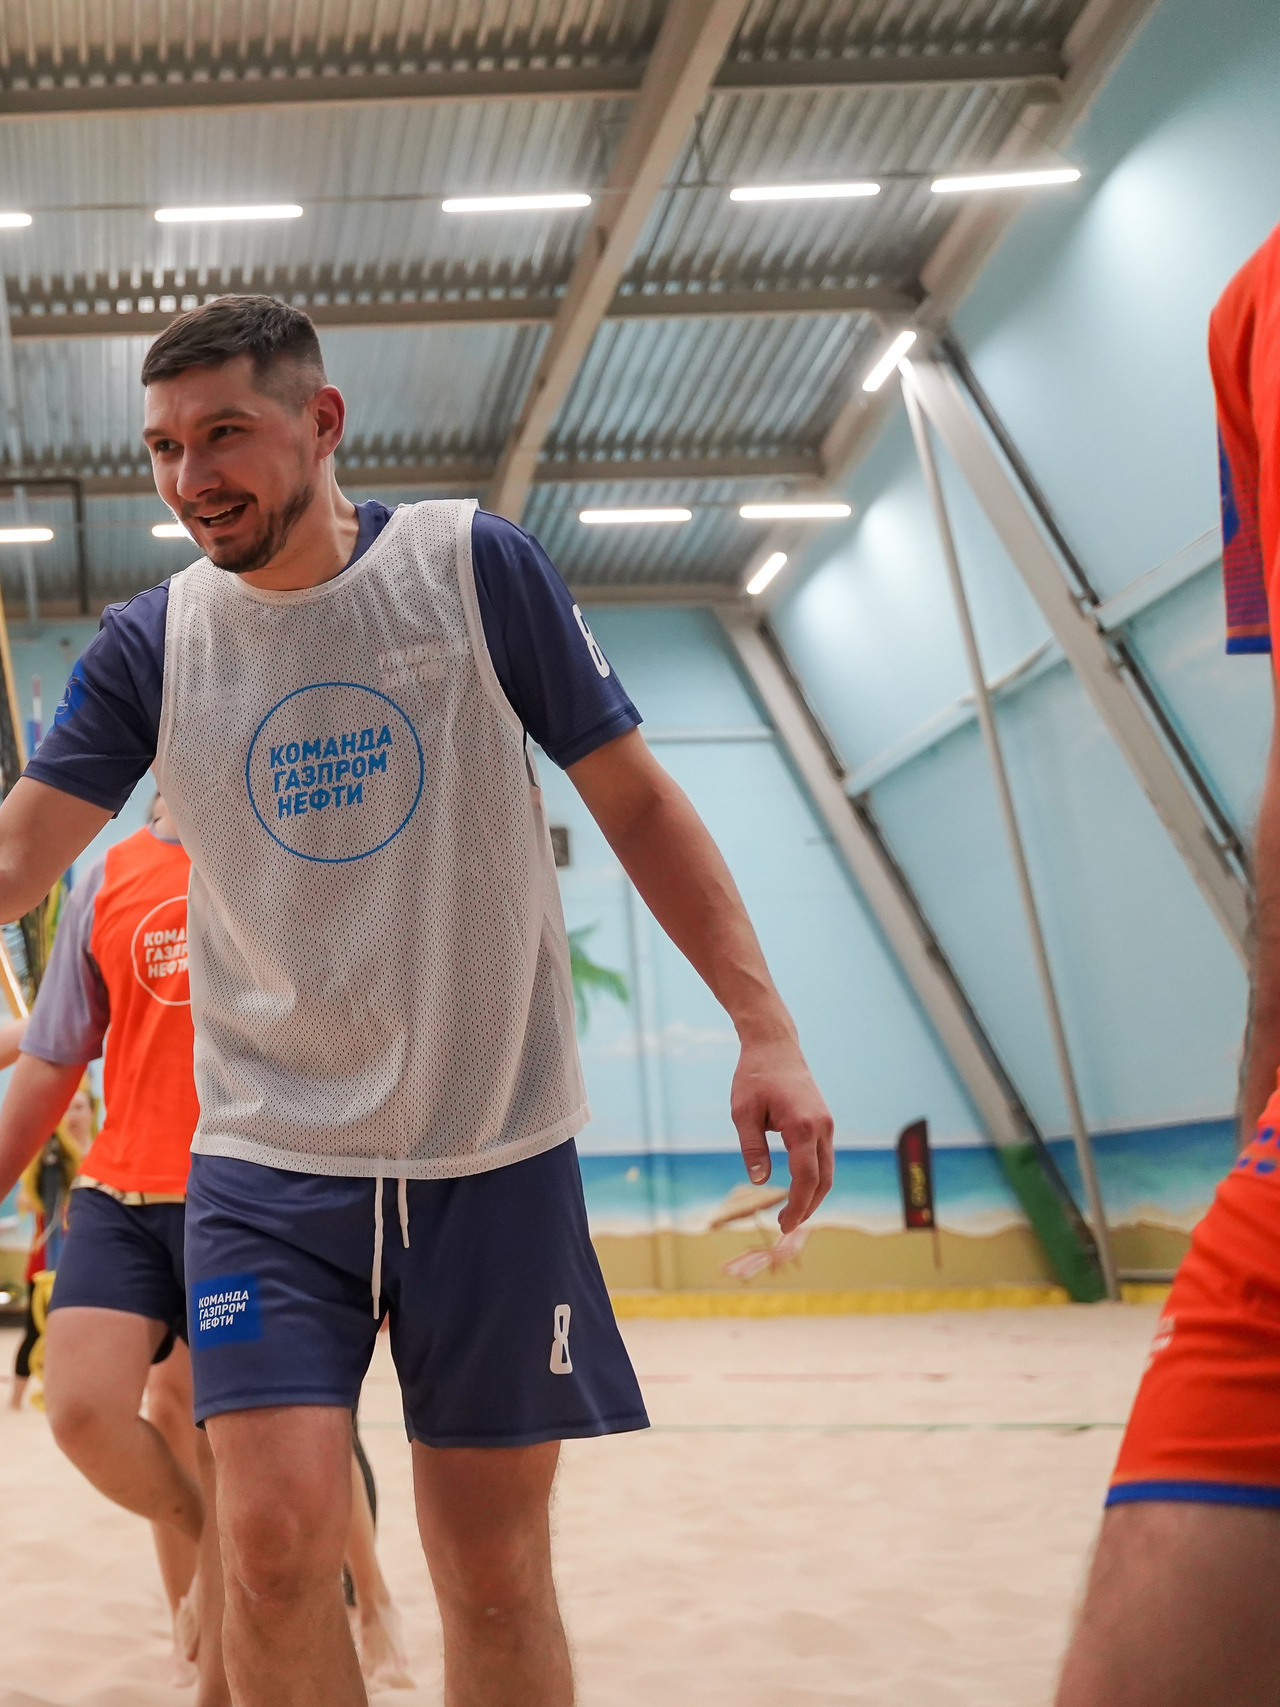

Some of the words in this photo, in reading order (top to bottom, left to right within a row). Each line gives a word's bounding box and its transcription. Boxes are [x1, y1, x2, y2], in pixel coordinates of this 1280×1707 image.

[270, 725, 393, 769] КОМАНДА
[274, 750, 388, 793] ГАЗПРОМ
[277, 783, 364, 819] НЕФТИ
[143, 927, 187, 947] КОМА
[145, 942, 188, 963] ГАЗПР
[198, 1290, 249, 1309] КОМАНДА
[199, 1302, 246, 1320] ГАЗПРОМ
[200, 1314, 234, 1331] НЕФТИ
[549, 1303, 573, 1375] 8
